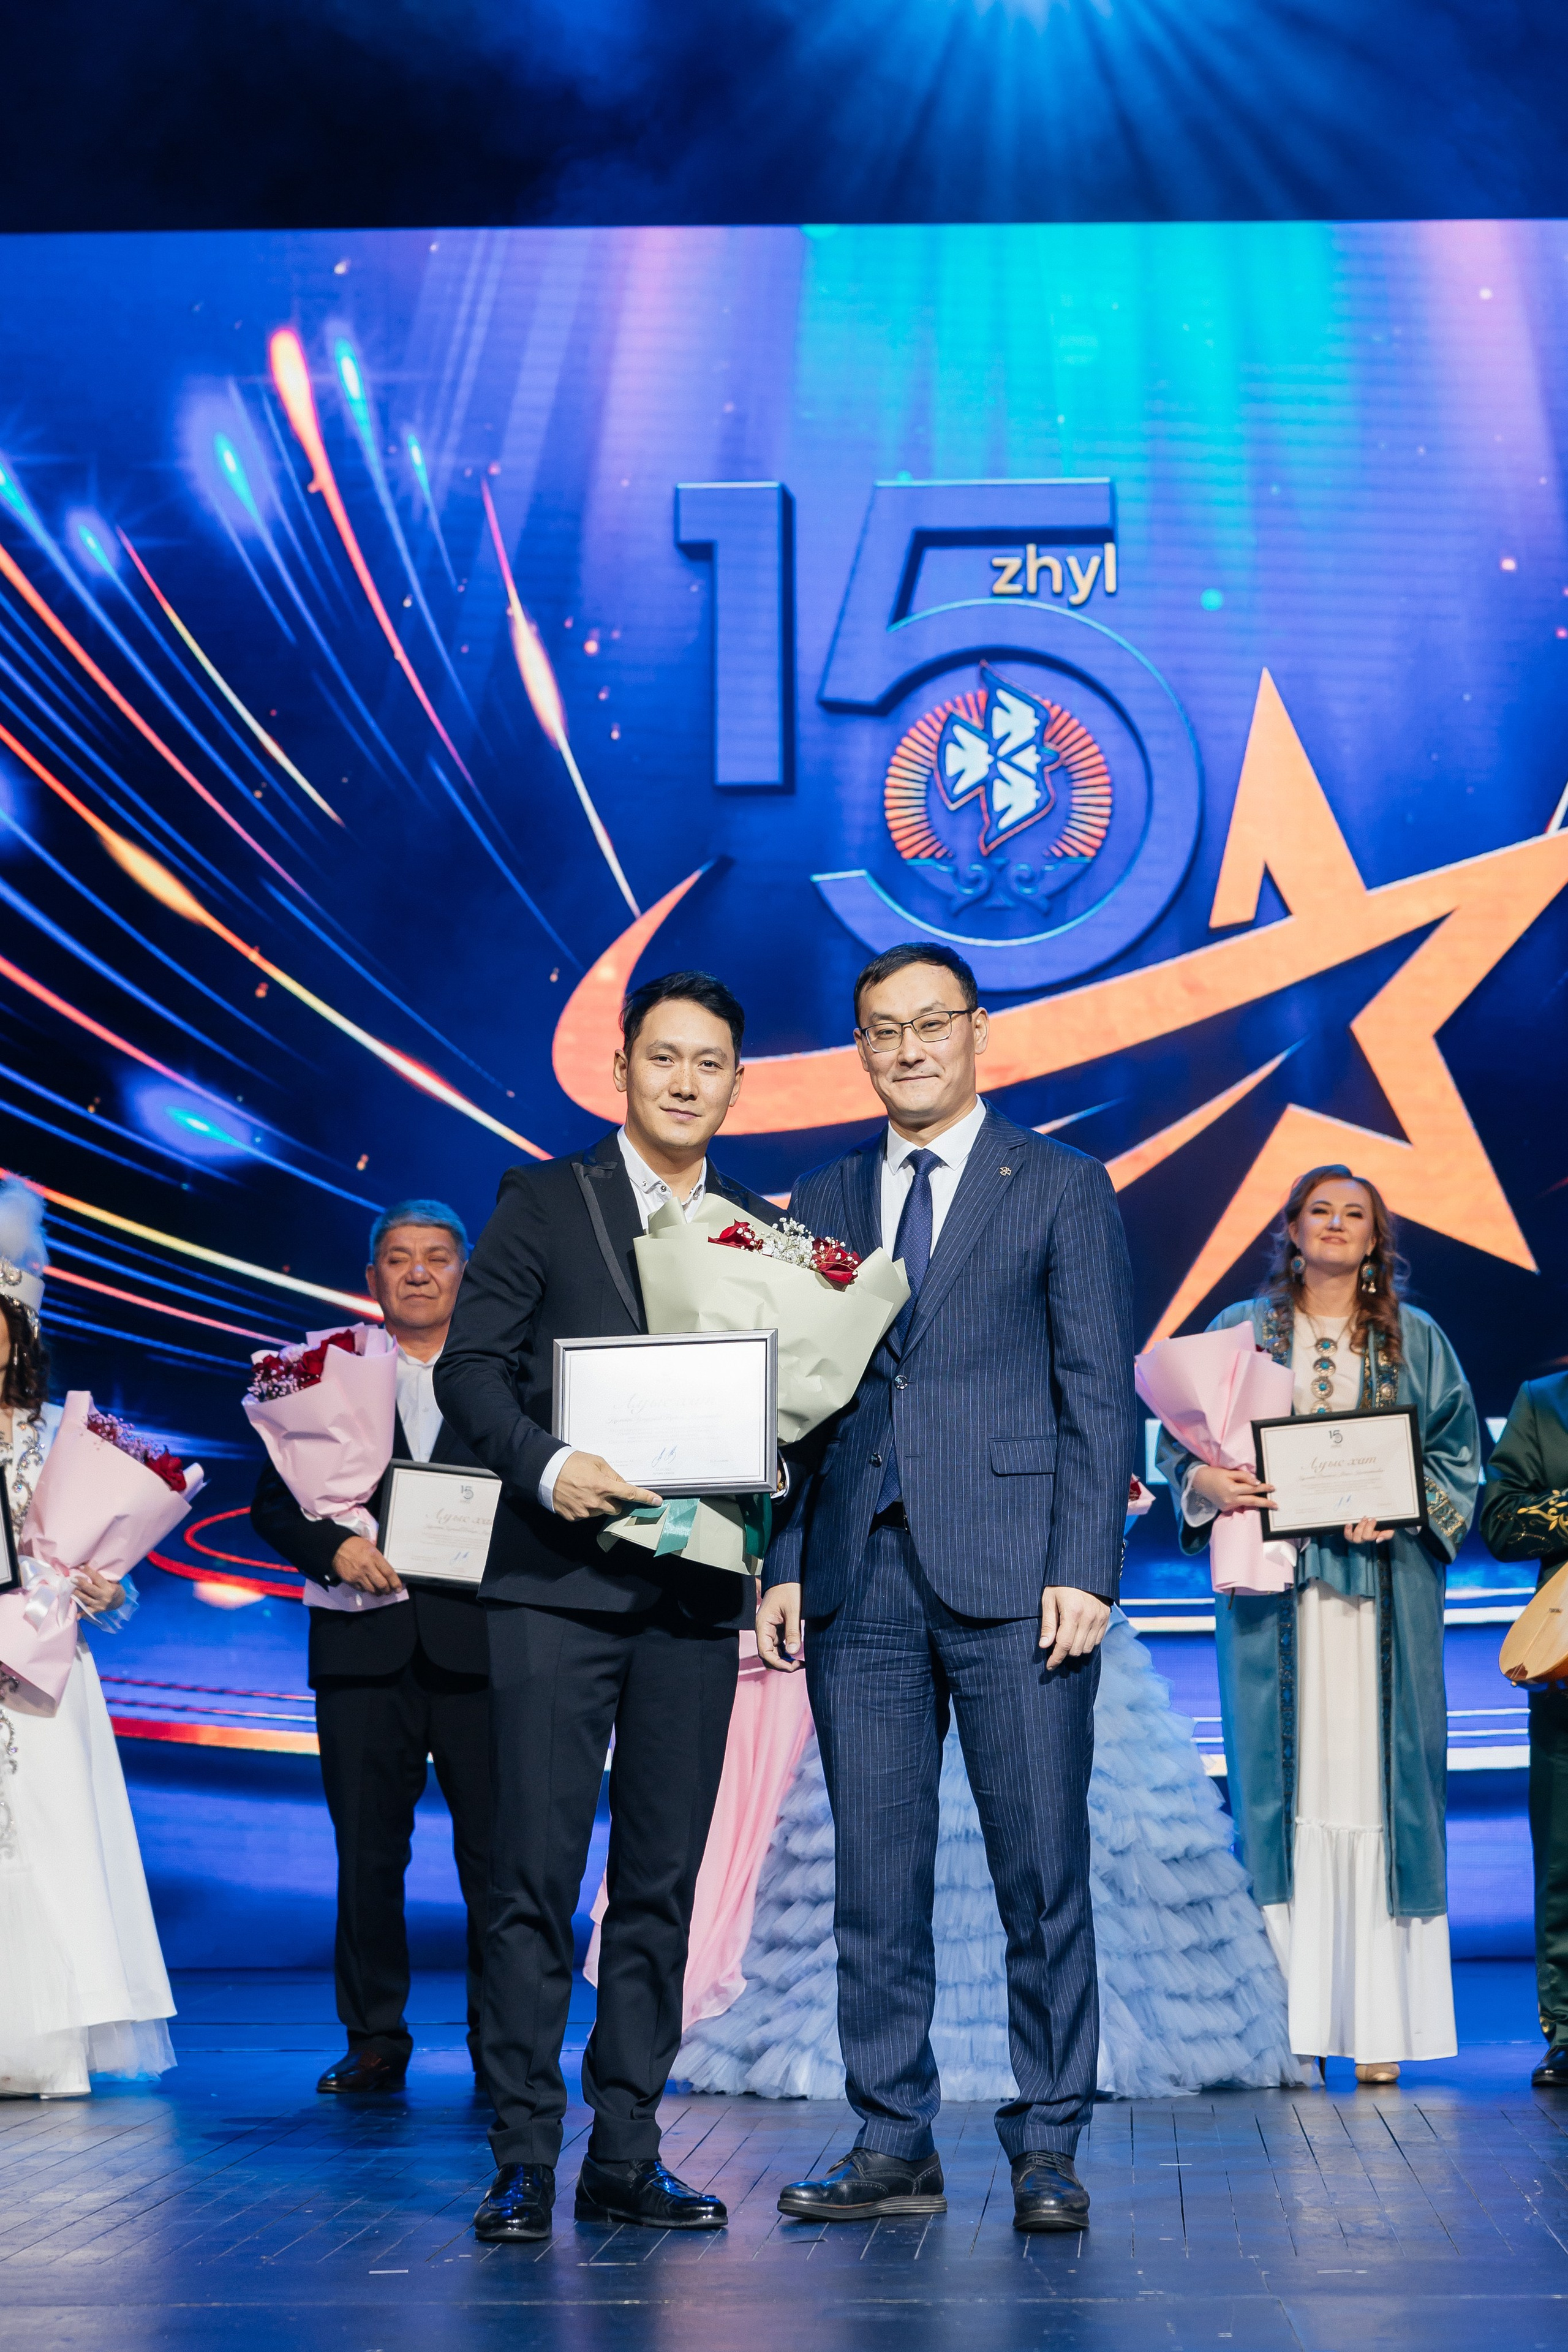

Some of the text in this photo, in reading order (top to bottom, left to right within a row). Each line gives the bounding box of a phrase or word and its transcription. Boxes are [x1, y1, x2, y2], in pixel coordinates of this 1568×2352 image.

[991, 542, 1117, 605] zhyl
[676, 478, 1204, 992] 15
[1329, 1429, 1343, 1444] 15
[461, 1485, 474, 1499] 15
